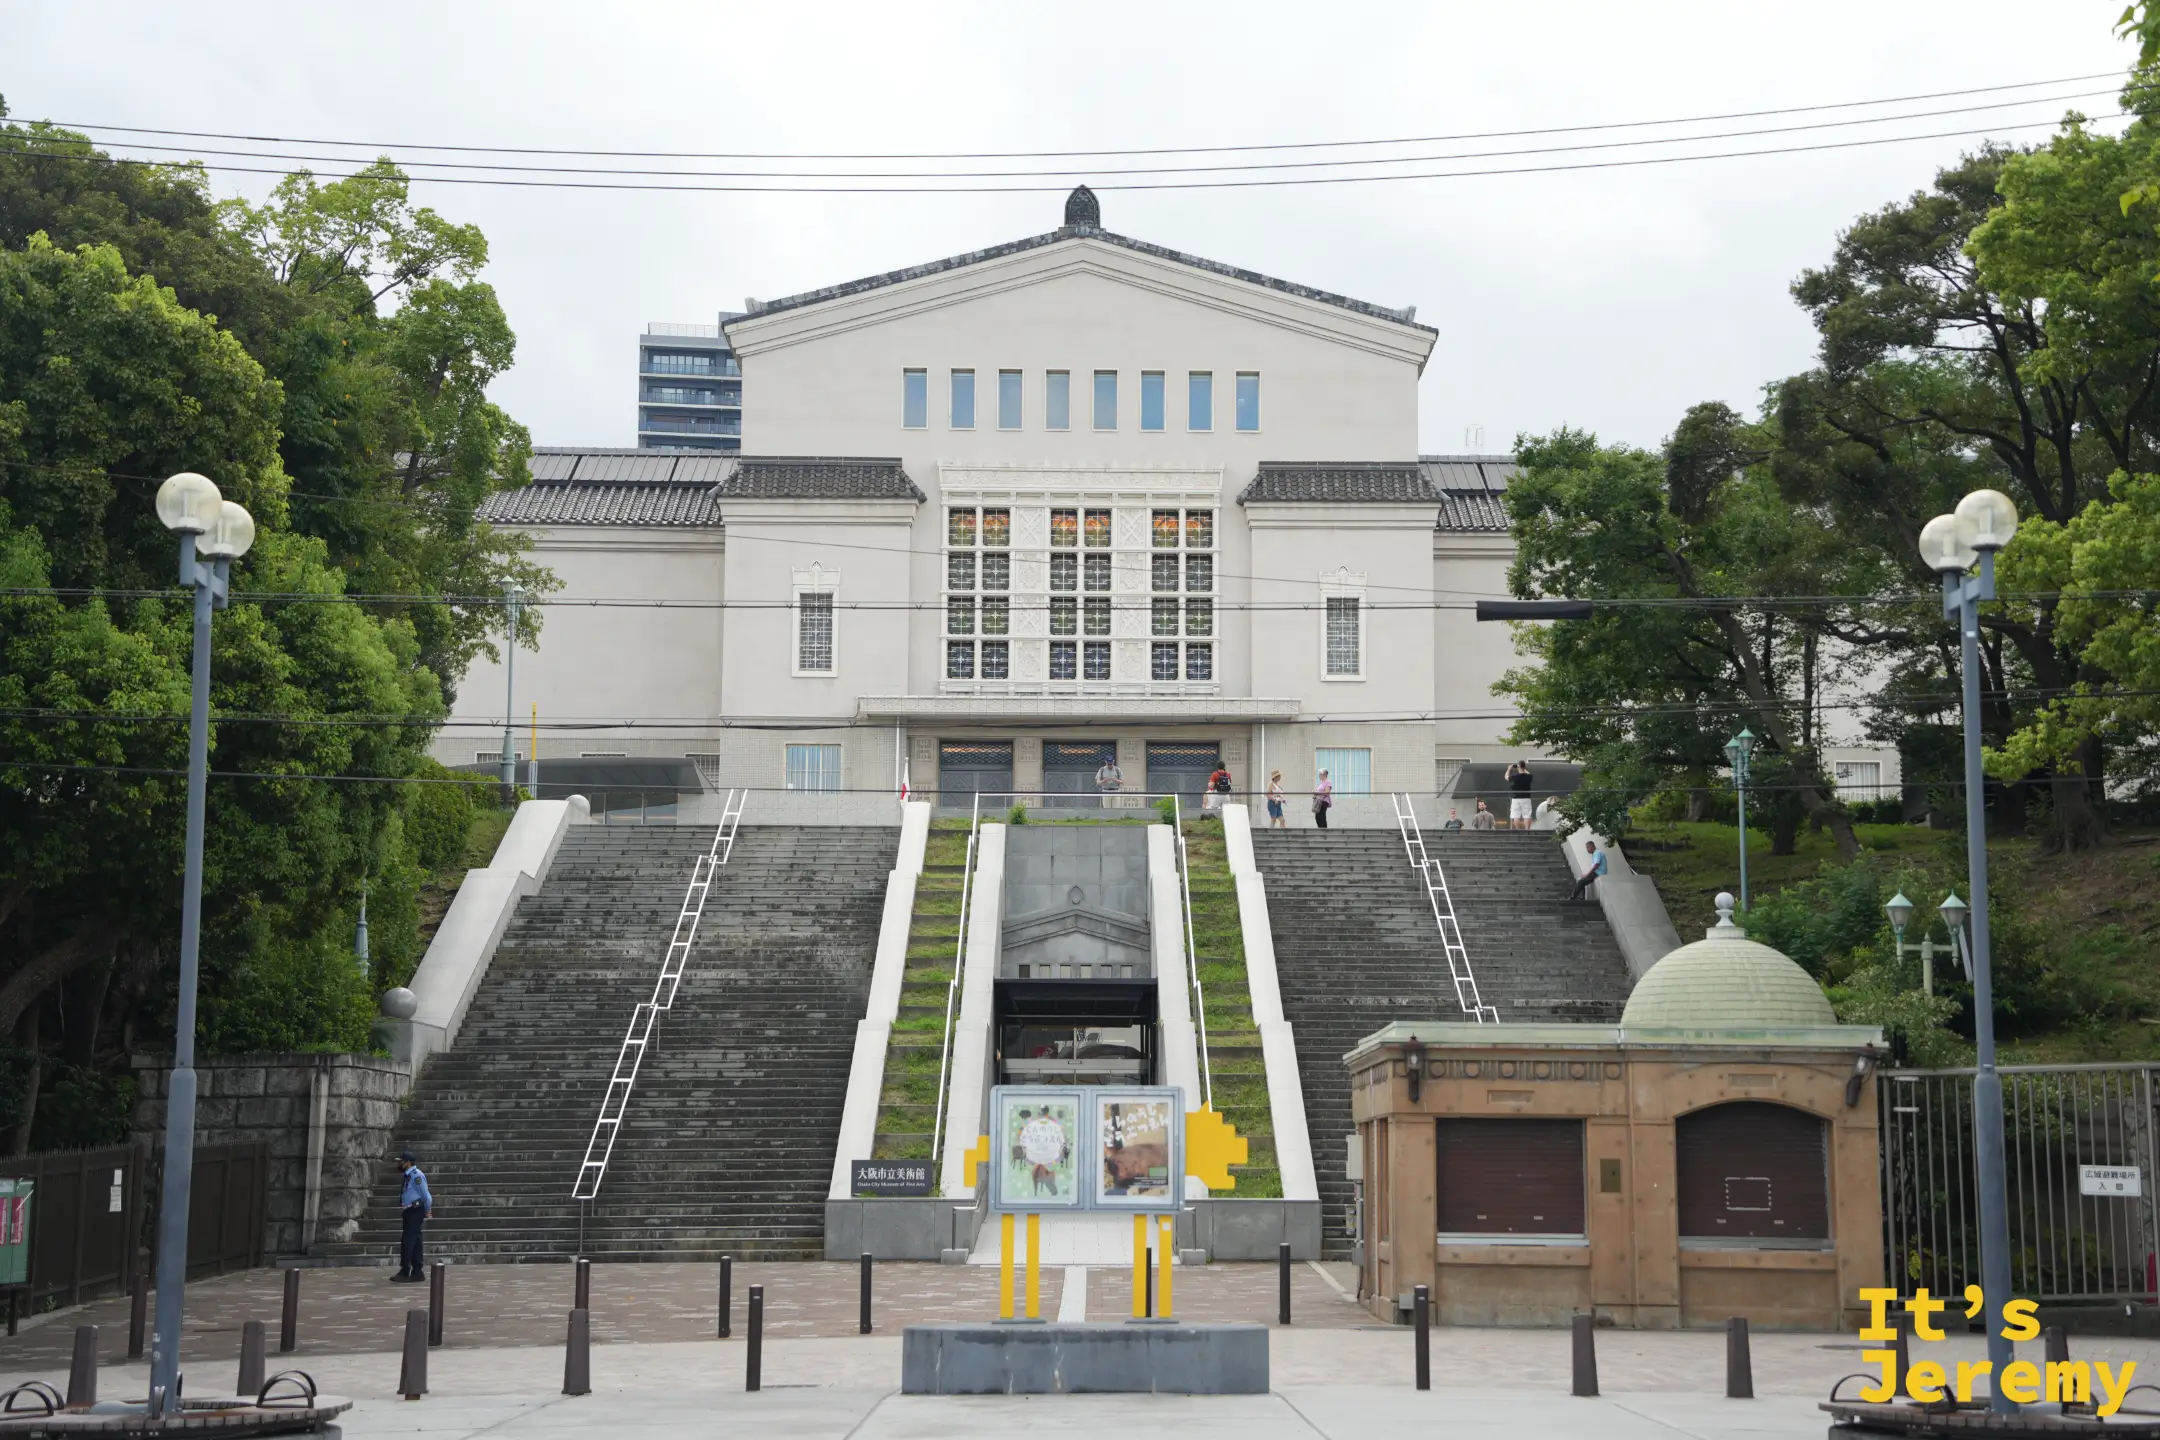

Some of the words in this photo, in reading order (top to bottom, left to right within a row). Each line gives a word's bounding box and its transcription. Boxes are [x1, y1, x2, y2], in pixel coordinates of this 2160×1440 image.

[857, 1167, 926, 1180] 大阪市立美術館
[2085, 1170, 2136, 1180] 広域避難場所
